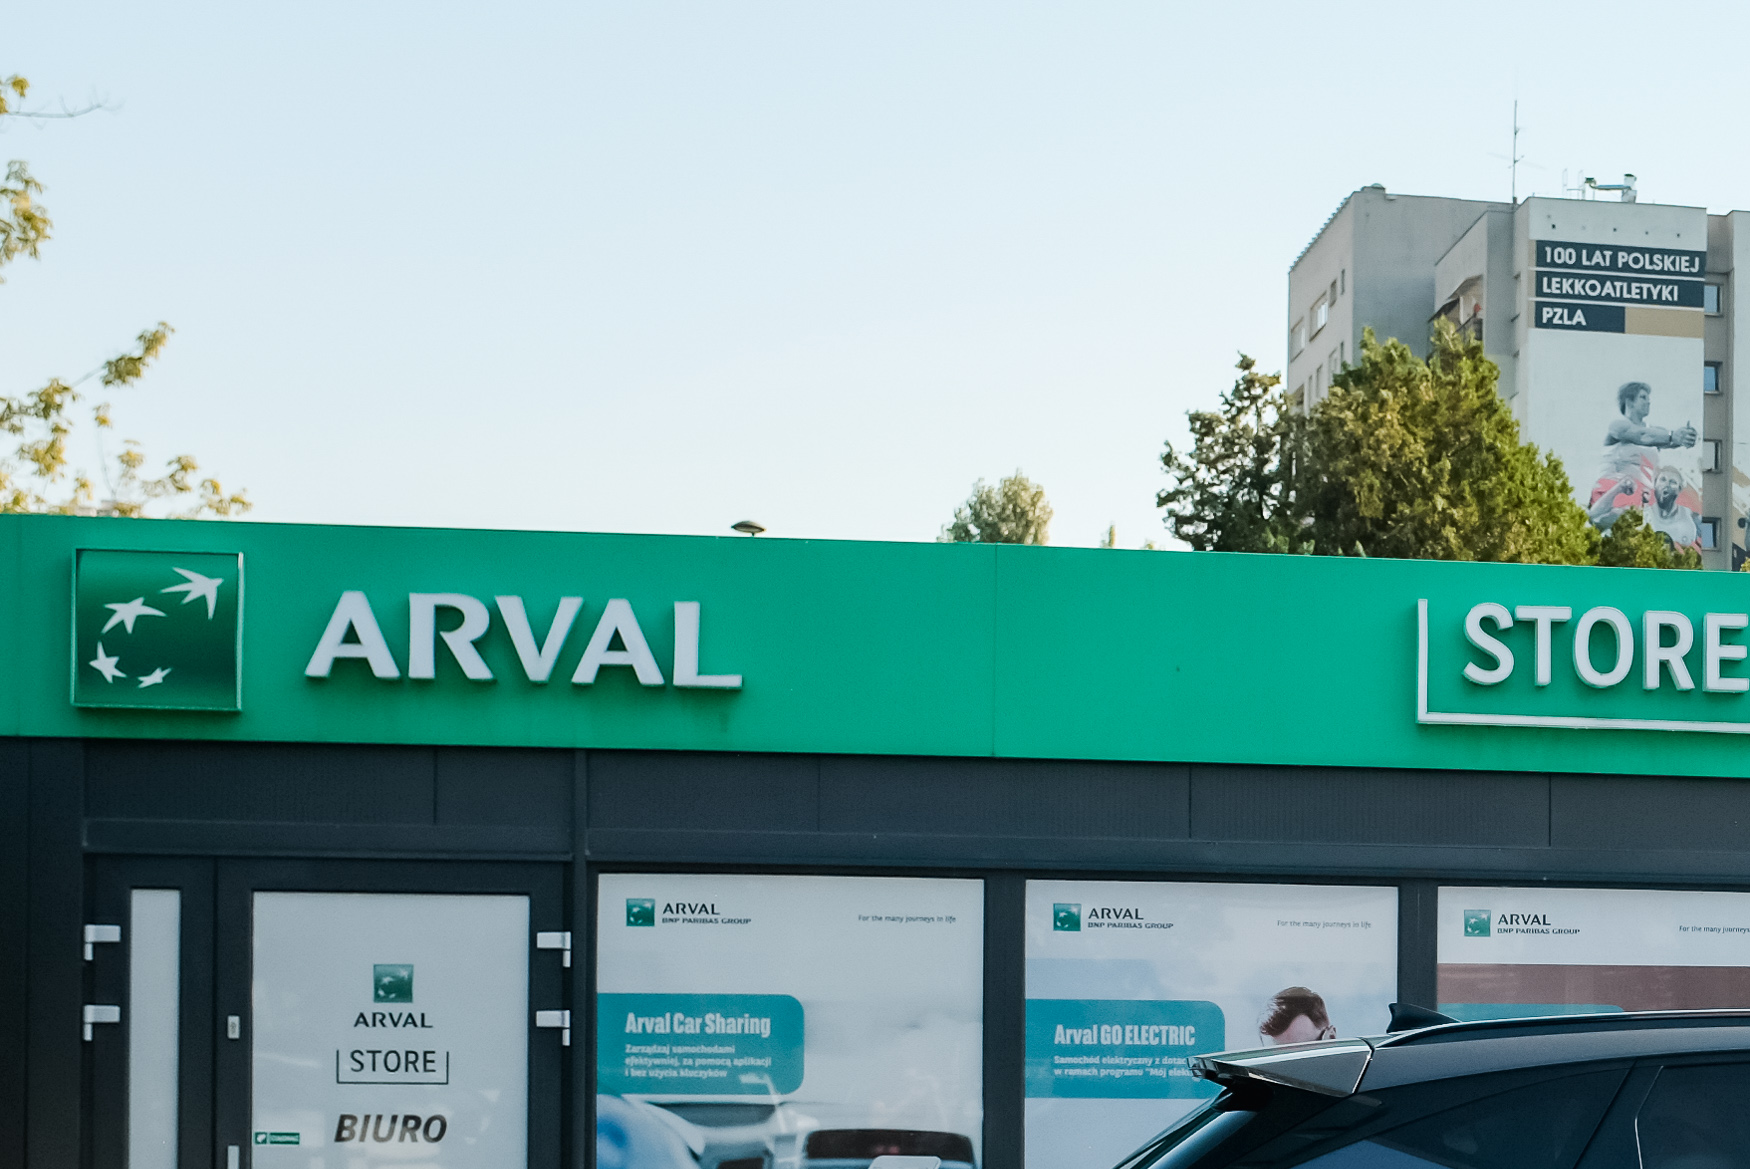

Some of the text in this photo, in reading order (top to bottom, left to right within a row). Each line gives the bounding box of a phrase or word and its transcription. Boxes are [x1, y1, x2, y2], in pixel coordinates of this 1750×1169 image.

[1544, 246, 1699, 273] 100 LAT POLSKIEJ
[1542, 276, 1679, 301] LEKKOATLETYKI
[1542, 307, 1587, 326] PZLA
[304, 590, 743, 688] ARVAL
[1462, 601, 1750, 694] STORE
[662, 902, 721, 915] ARVAL
[1088, 907, 1144, 920] ARVAL
[1497, 913, 1552, 926] ARVAL
[1703, 926, 1721, 934] many
[354, 1012, 434, 1028] ARVAL
[625, 1012, 771, 1038] Arval Car Sharing
[1054, 1024, 1196, 1046] Arval GO ELECTRIC
[350, 1050, 436, 1073] STORE
[682, 1058, 694, 1066] za
[1054, 1055, 1100, 1064] Samochód
[1102, 1055, 1153, 1067] elektryczny
[1161, 1056, 1187, 1064] dotac
[1064, 1067, 1098, 1076] ramach
[1100, 1068, 1144, 1079] programu
[334, 1114, 447, 1144] BIURO
